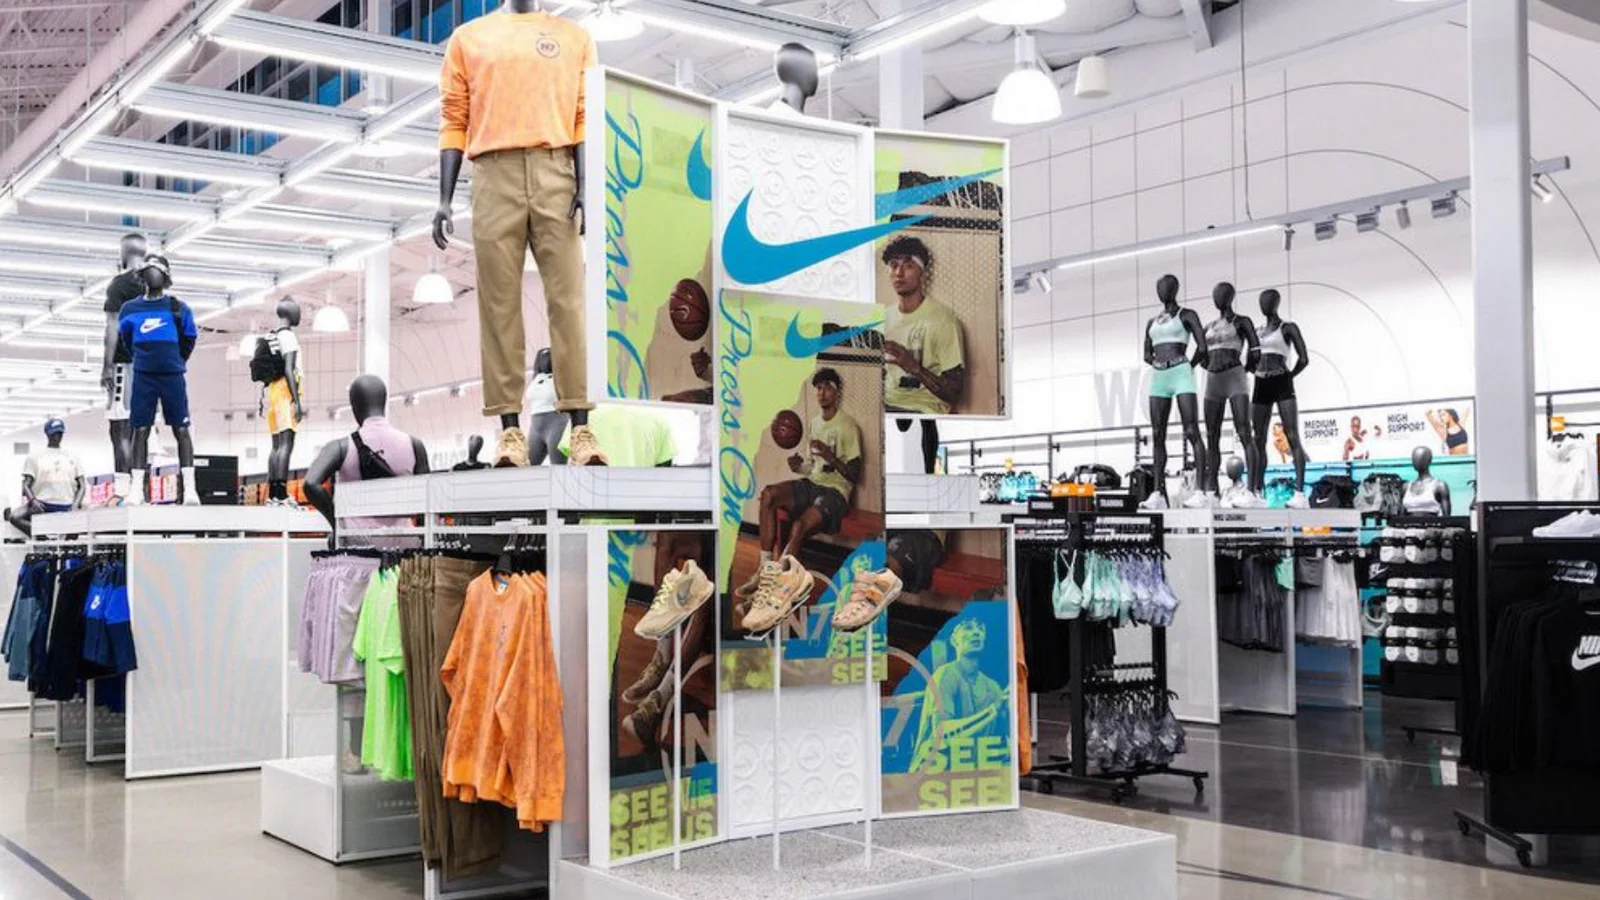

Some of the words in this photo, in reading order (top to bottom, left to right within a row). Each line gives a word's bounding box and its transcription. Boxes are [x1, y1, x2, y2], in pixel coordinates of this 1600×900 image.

[718, 287, 753, 436] Press
[1304, 419, 1337, 429] MEDIUM
[1387, 413, 1408, 423] HIGH
[1387, 421, 1425, 434] SUPPORT
[1303, 428, 1339, 439] SUPPORT
[833, 631, 886, 659] SEE
[831, 661, 883, 685] SEE
[918, 736, 1003, 775] SEE
[610, 785, 668, 827] SEE
[918, 775, 1003, 810] SEE
[610, 821, 668, 860] SEE
